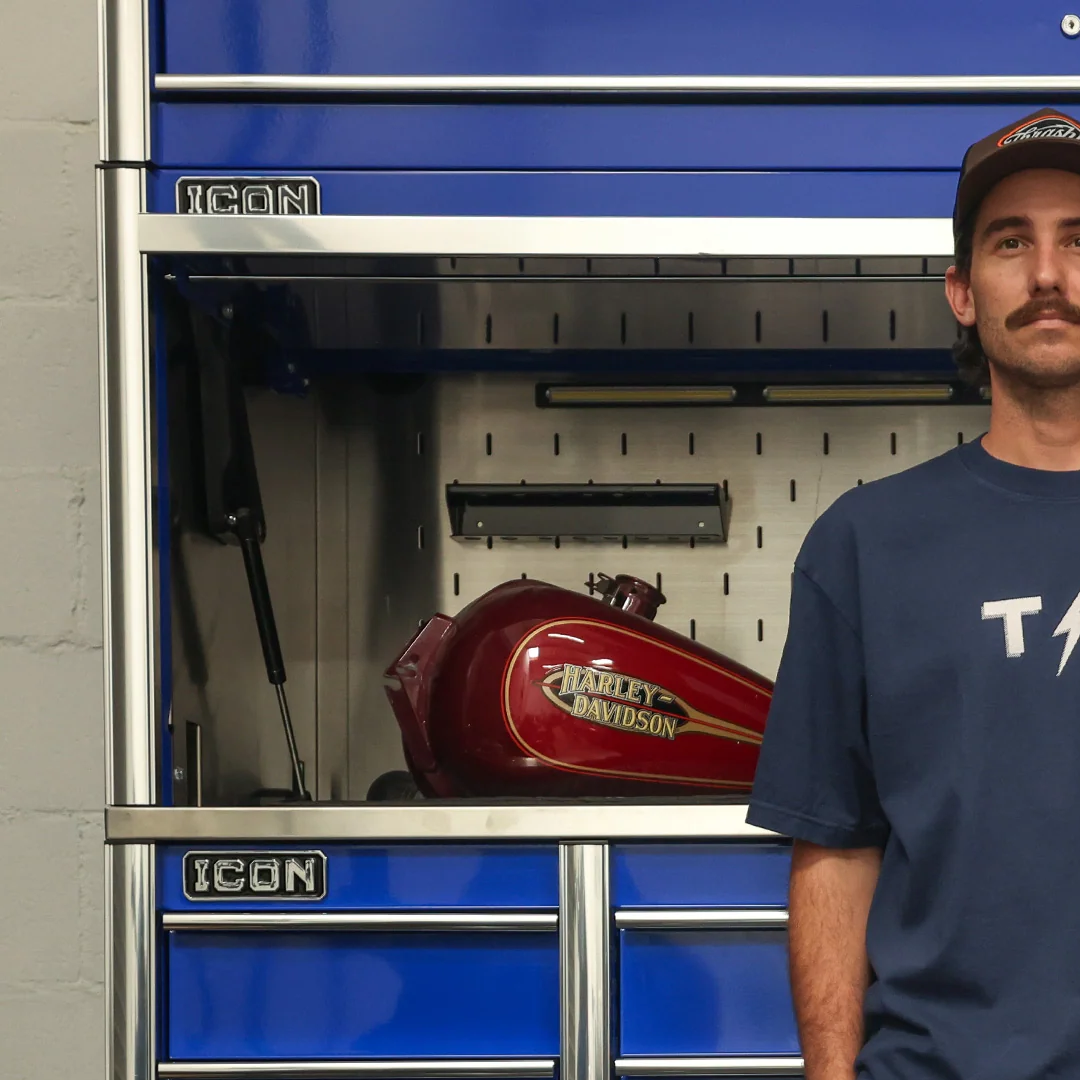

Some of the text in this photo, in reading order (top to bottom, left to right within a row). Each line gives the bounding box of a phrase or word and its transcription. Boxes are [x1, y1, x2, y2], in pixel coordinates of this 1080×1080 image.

[187, 184, 308, 214] ICON
[981, 596, 1042, 657] T
[570, 693, 678, 740] DAVIDSON
[195, 858, 314, 891] ICON
